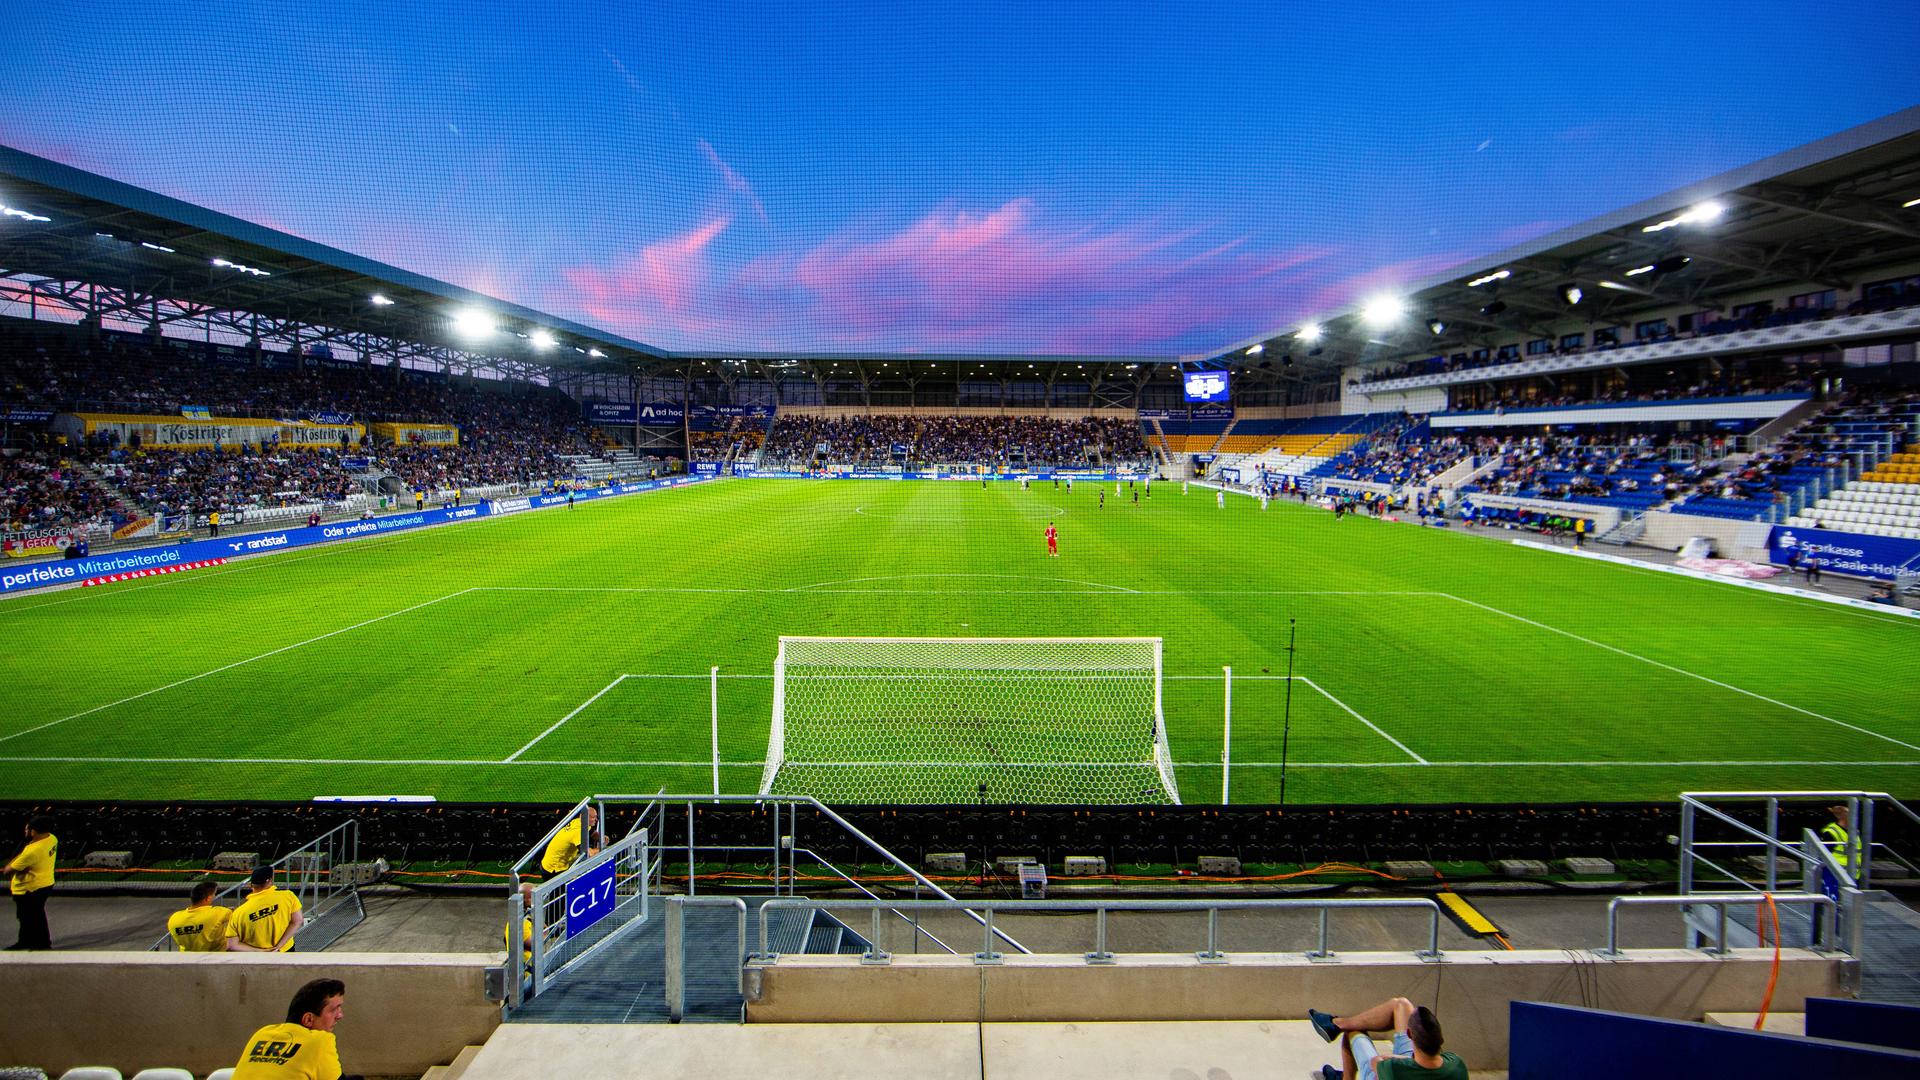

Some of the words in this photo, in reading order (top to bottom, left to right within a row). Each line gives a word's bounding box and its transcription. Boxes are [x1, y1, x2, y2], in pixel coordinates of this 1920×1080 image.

[655, 408, 666, 416] ad
[668, 408, 683, 417] hoc
[696, 463, 717, 471] REWE
[455, 507, 476, 518] randstad
[323, 526, 344, 538] Oder
[345, 522, 377, 536] perfekte
[377, 515, 425, 530] Mitarbeitende!
[3, 526, 73, 543] FETTGUSCHEN
[26, 537, 55, 549] GERA
[247, 535, 287, 549] randstad
[2, 566, 75, 588] perfekte
[78, 551, 181, 575] Mitarbeitende!
[569, 876, 613, 918] C17
[249, 1056, 288, 1066] Security
